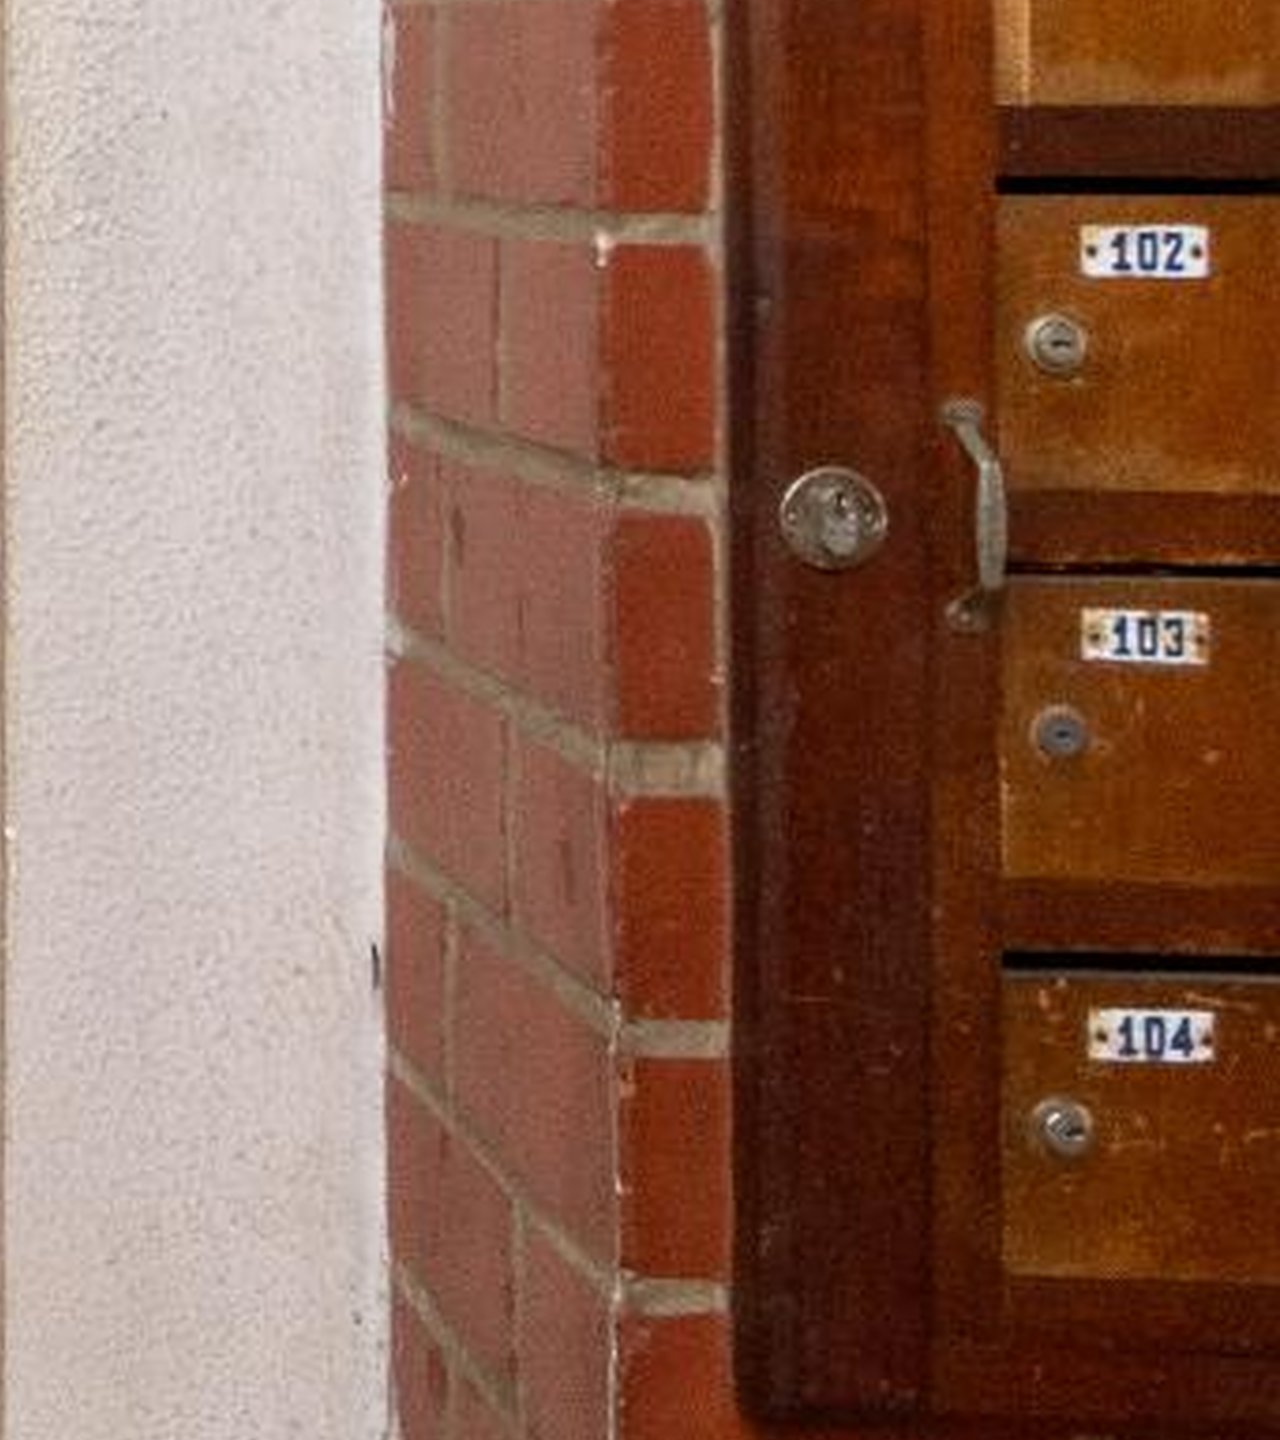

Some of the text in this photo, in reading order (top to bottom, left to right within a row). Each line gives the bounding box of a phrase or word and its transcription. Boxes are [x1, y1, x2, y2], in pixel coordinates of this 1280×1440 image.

[1109, 232, 1185, 272] 102
[1112, 615, 1185, 657] 103
[1117, 1016, 1195, 1058] 104
